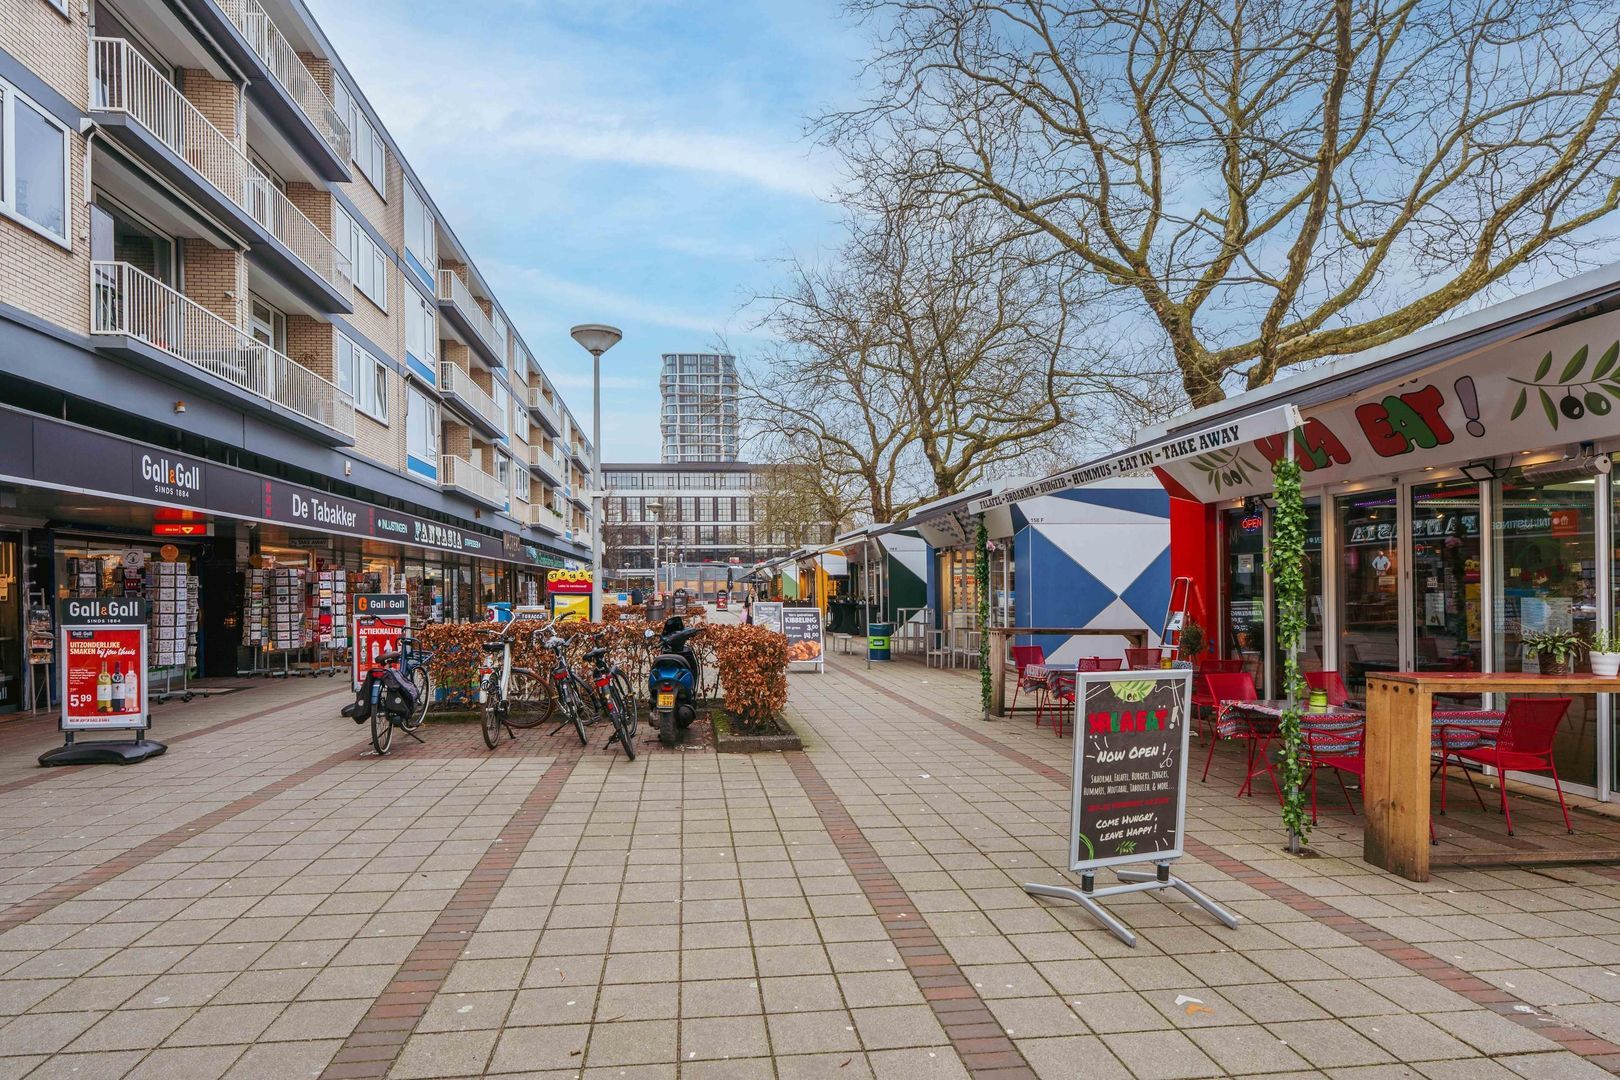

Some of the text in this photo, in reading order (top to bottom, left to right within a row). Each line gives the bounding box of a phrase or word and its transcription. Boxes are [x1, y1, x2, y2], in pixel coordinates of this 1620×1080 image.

[979, 496, 1003, 510] FALAFEL
[1005, 486, 1037, 503] SHOARMA
[1072, 463, 1112, 485] HUMMUS
[1118, 455, 1140, 472] EAT
[1140, 451, 1154, 466] IN
[1162, 437, 1197, 459] TAKE
[1199, 425, 1240, 450] AWAY
[154, 485, 190, 498] SINDS 1884
[292, 493, 357, 528] De Tabakker
[1241, 518, 1262, 529] OPEN
[414, 521, 463, 550] FANTASIA
[69, 601, 139, 617] Gall&Gall
[785, 616, 817, 624] KIBBELING
[69, 641, 121, 649] UITZONDERLIJKE
